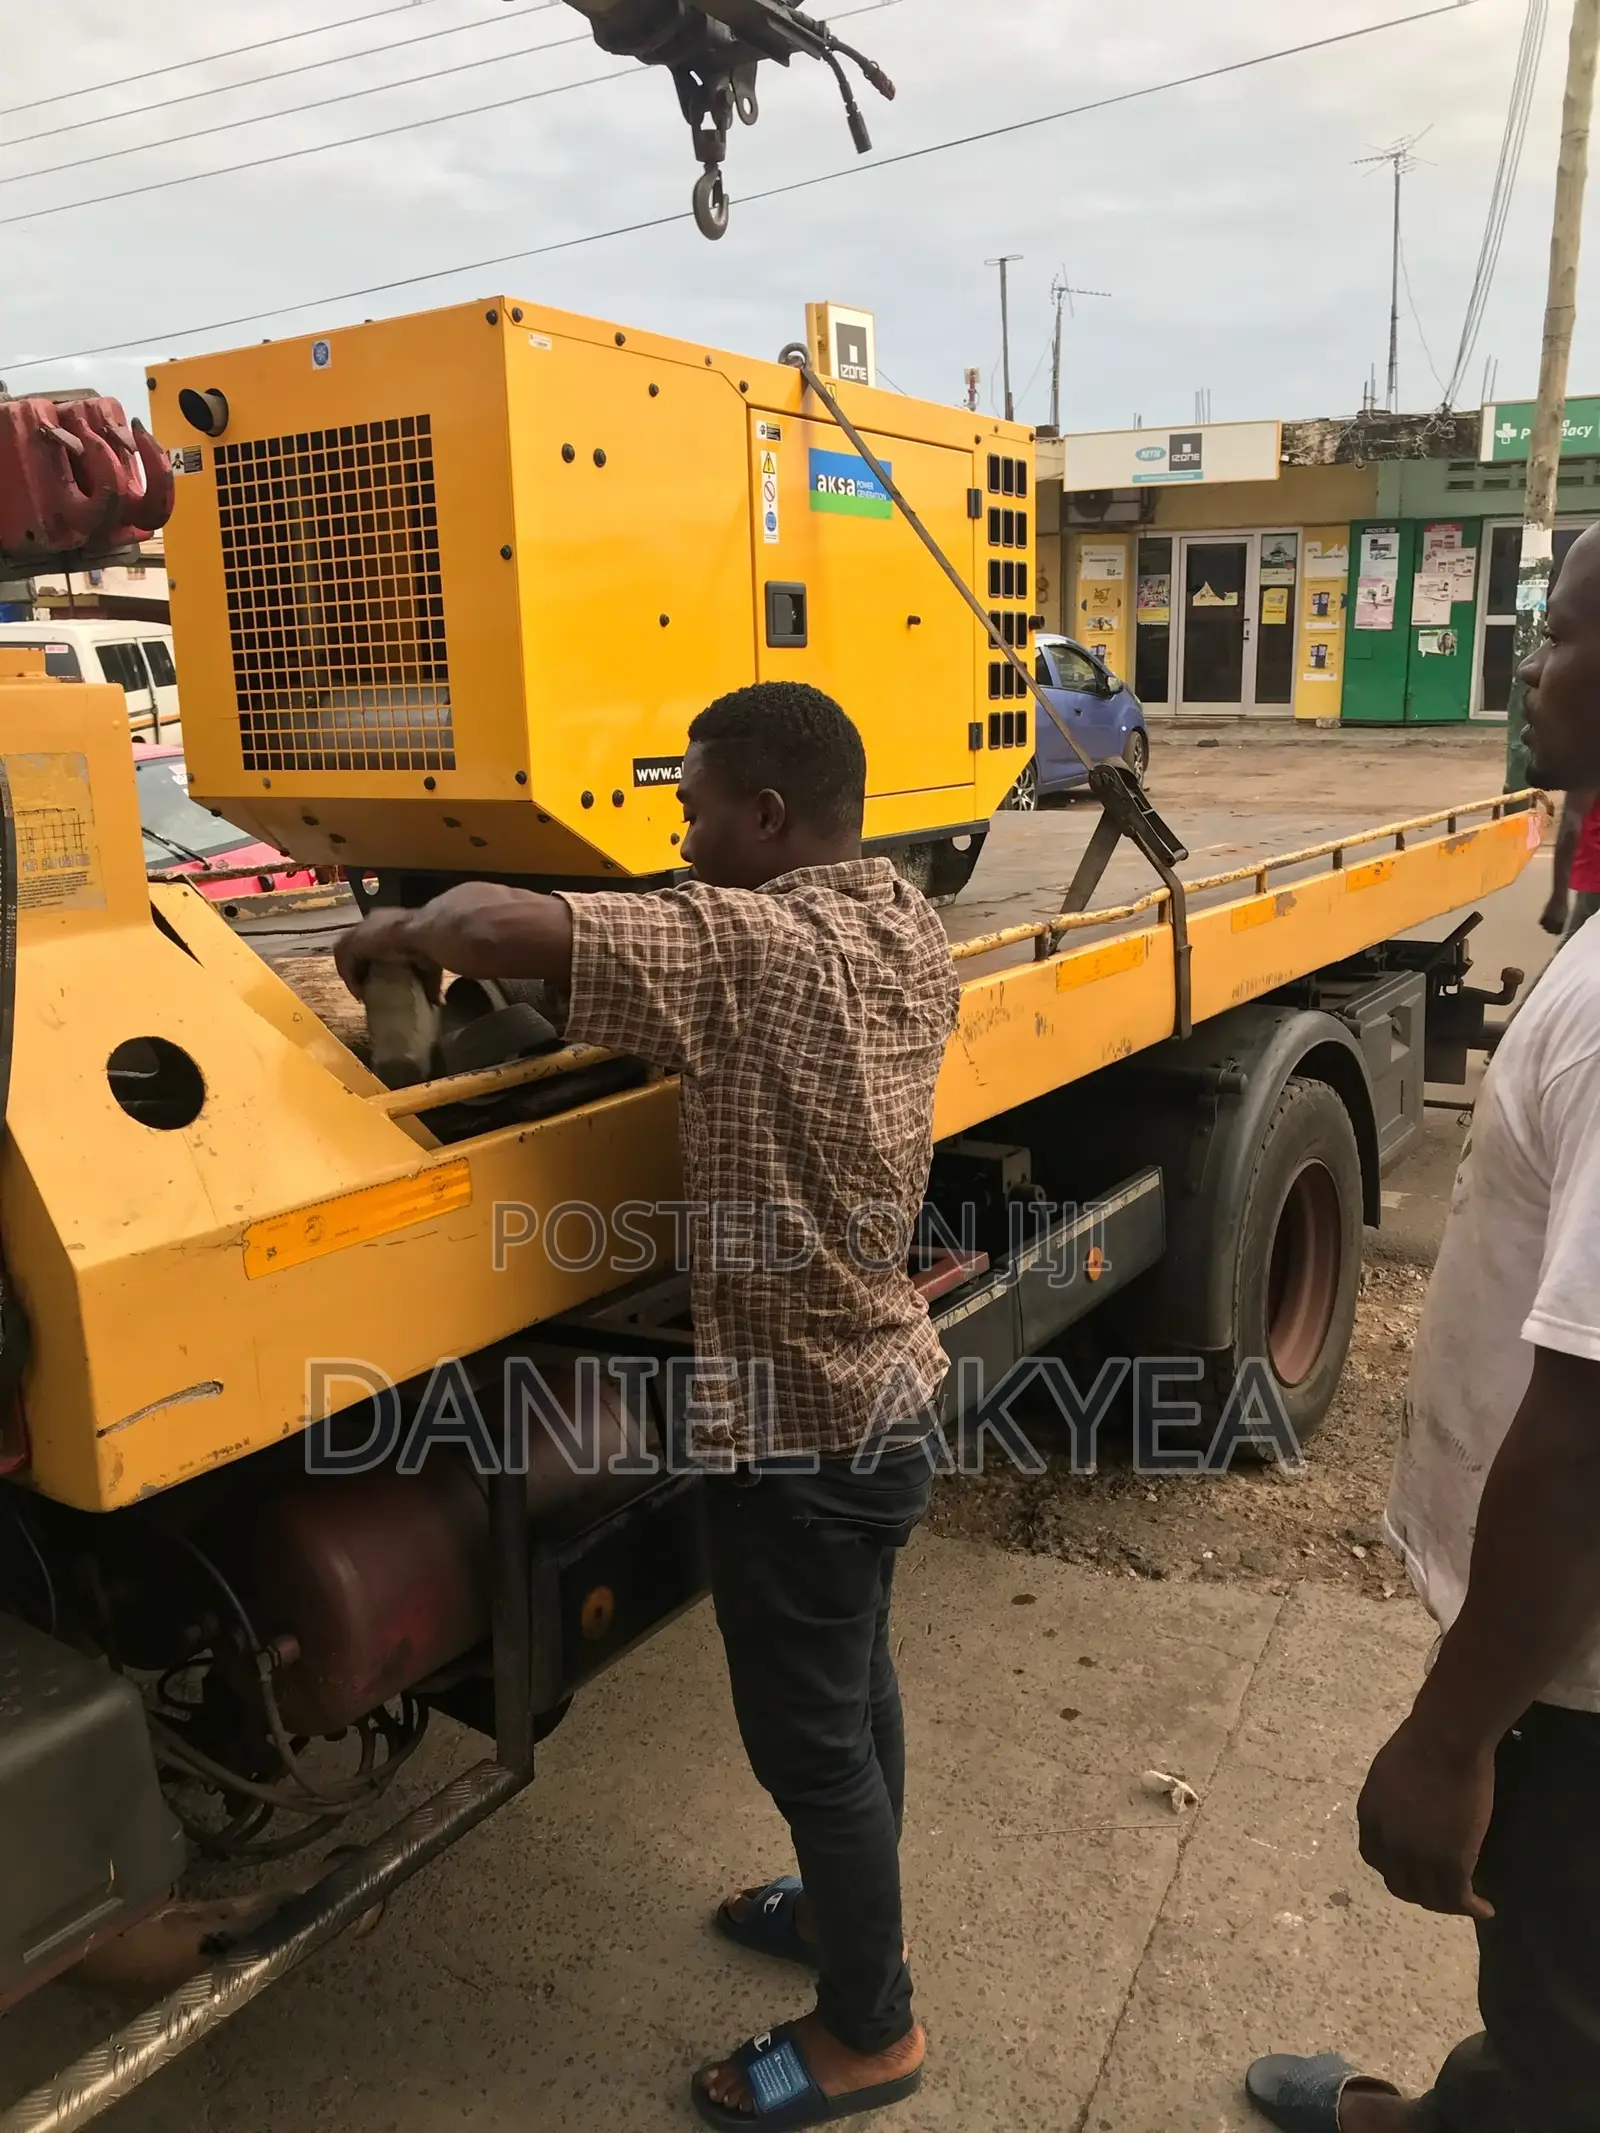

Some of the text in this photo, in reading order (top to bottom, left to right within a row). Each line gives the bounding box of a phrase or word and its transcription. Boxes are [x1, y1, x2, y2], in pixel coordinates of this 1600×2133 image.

[817, 473, 855, 497] aksa
[856, 480, 874, 490] POWER
[856, 489, 887, 501] GENERATION
